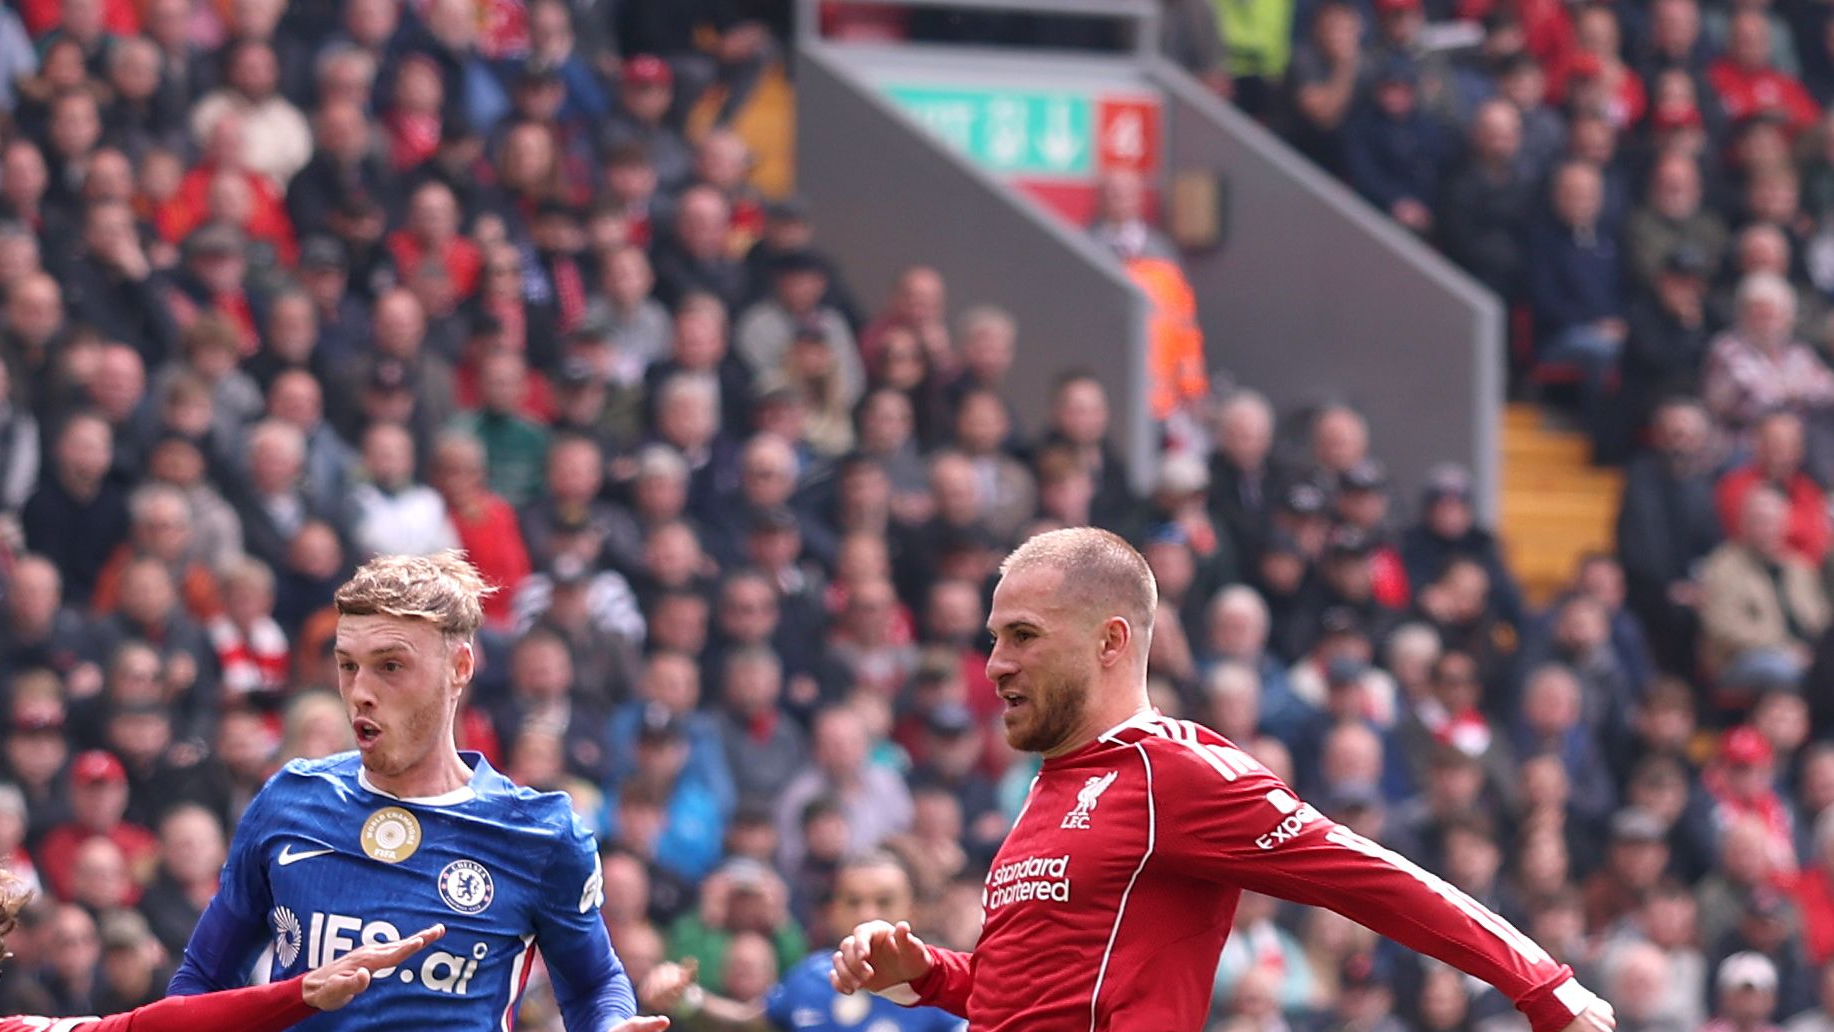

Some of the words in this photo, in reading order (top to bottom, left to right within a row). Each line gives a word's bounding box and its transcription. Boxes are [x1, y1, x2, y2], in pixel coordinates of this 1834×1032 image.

[374, 848, 397, 860] FIFA
[992, 855, 1070, 887] standard
[990, 878, 1070, 910] chartered
